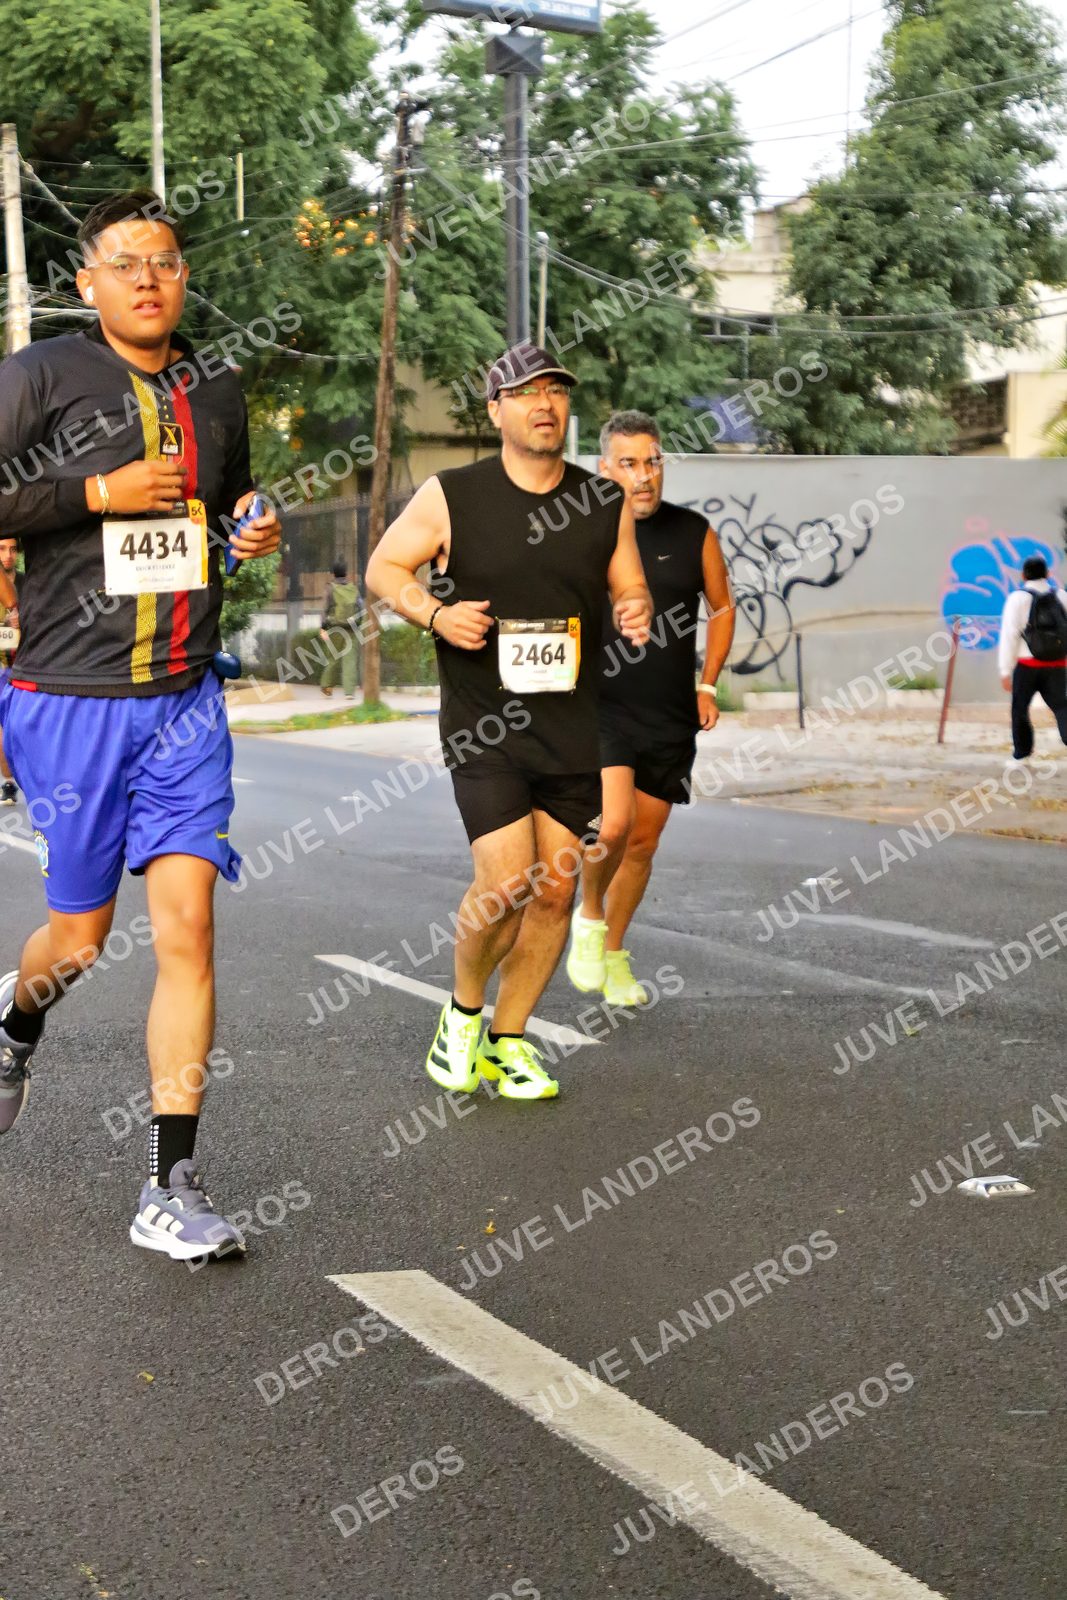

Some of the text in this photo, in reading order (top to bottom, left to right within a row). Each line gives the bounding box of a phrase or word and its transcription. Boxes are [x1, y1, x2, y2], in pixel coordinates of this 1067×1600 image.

[119, 530, 188, 561] 4434
[0, 631, 14, 639] 60
[511, 642, 566, 666] 2464
